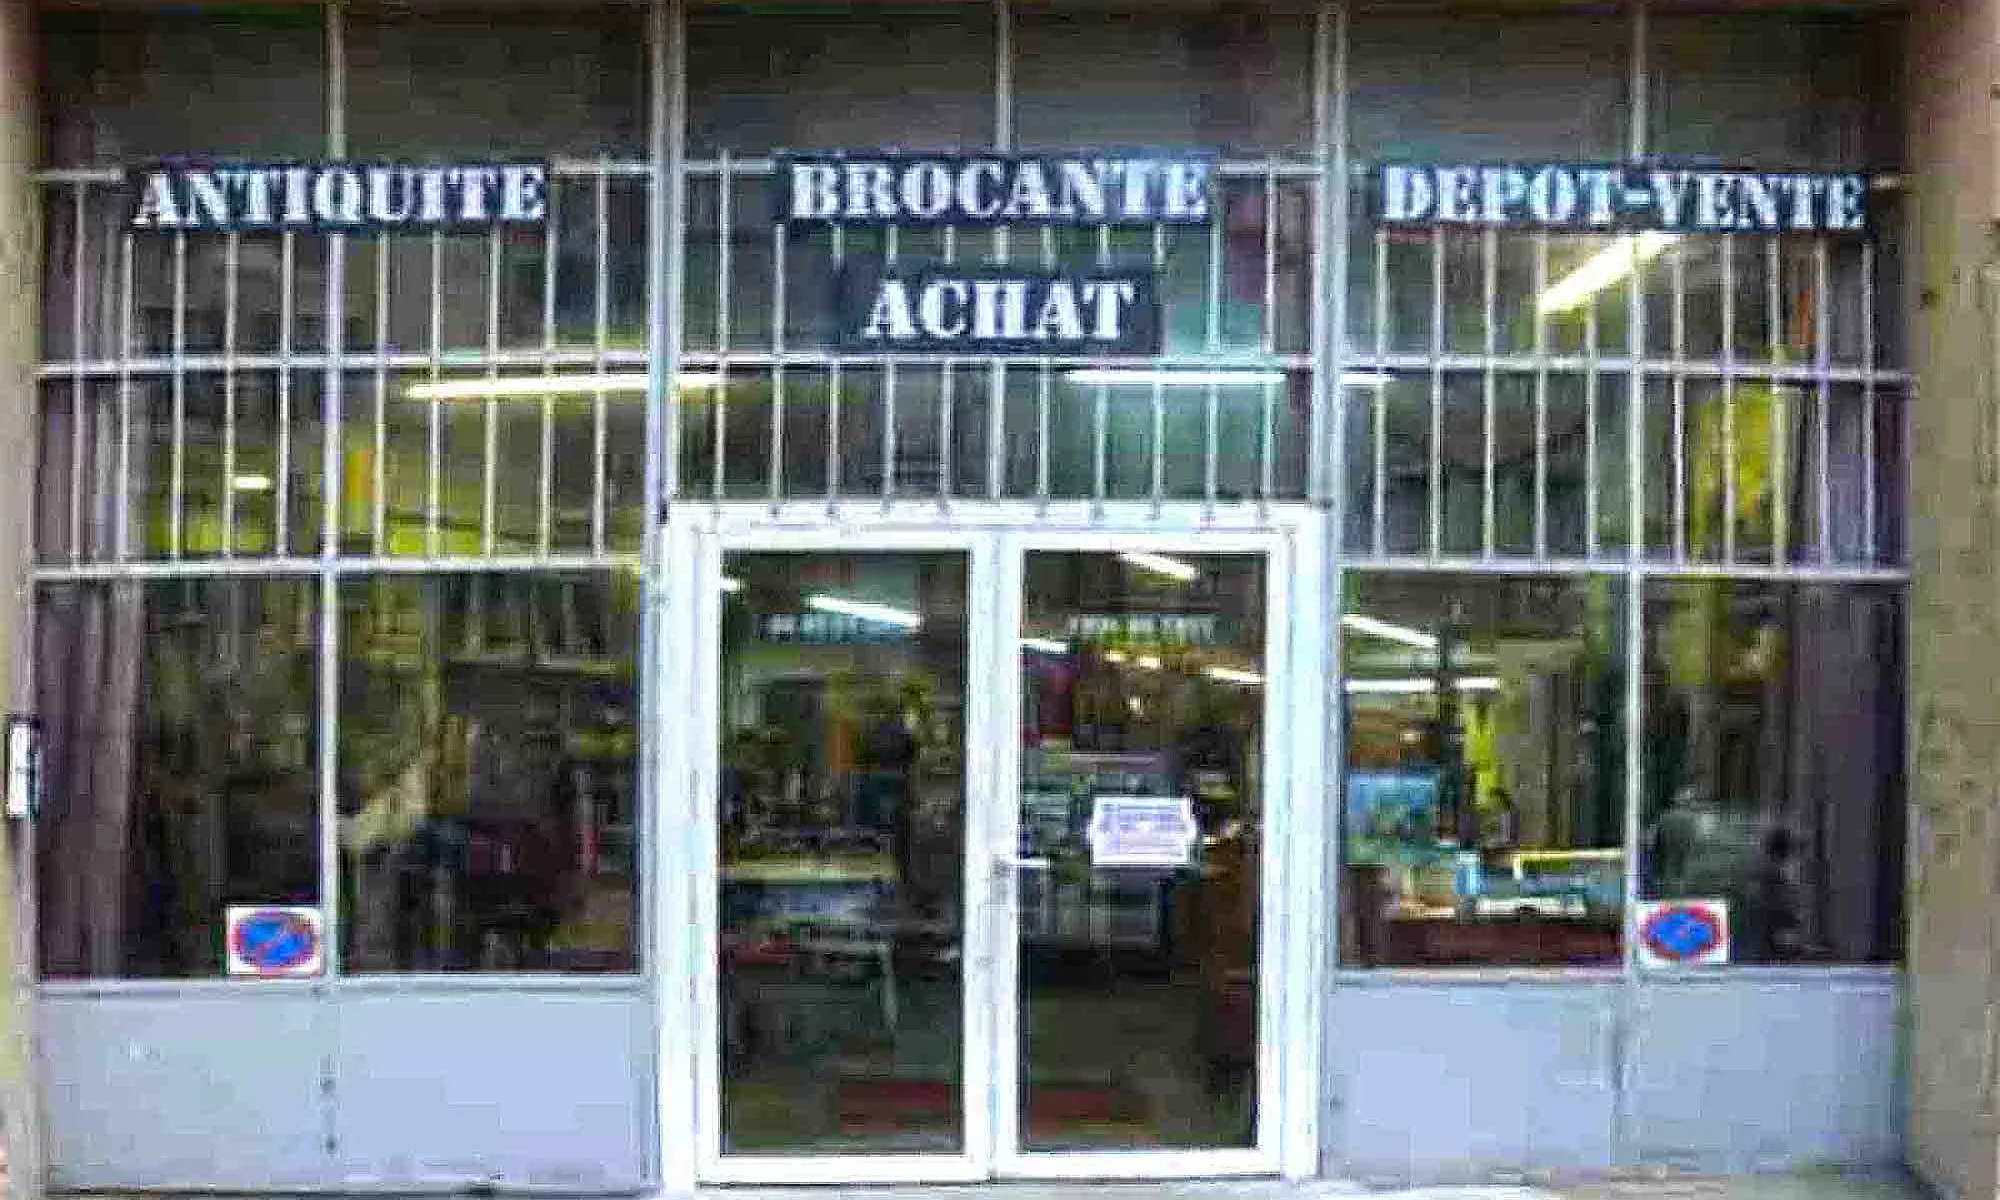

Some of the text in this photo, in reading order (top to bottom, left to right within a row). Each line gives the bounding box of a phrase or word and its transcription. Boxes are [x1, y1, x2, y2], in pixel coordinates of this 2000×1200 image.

[131, 166, 546, 226] ANTIQUITE
[790, 160, 1209, 220] BROCANTE
[1383, 165, 1865, 230] DEPOT-VENTE
[863, 279, 1137, 340] ACHAT
